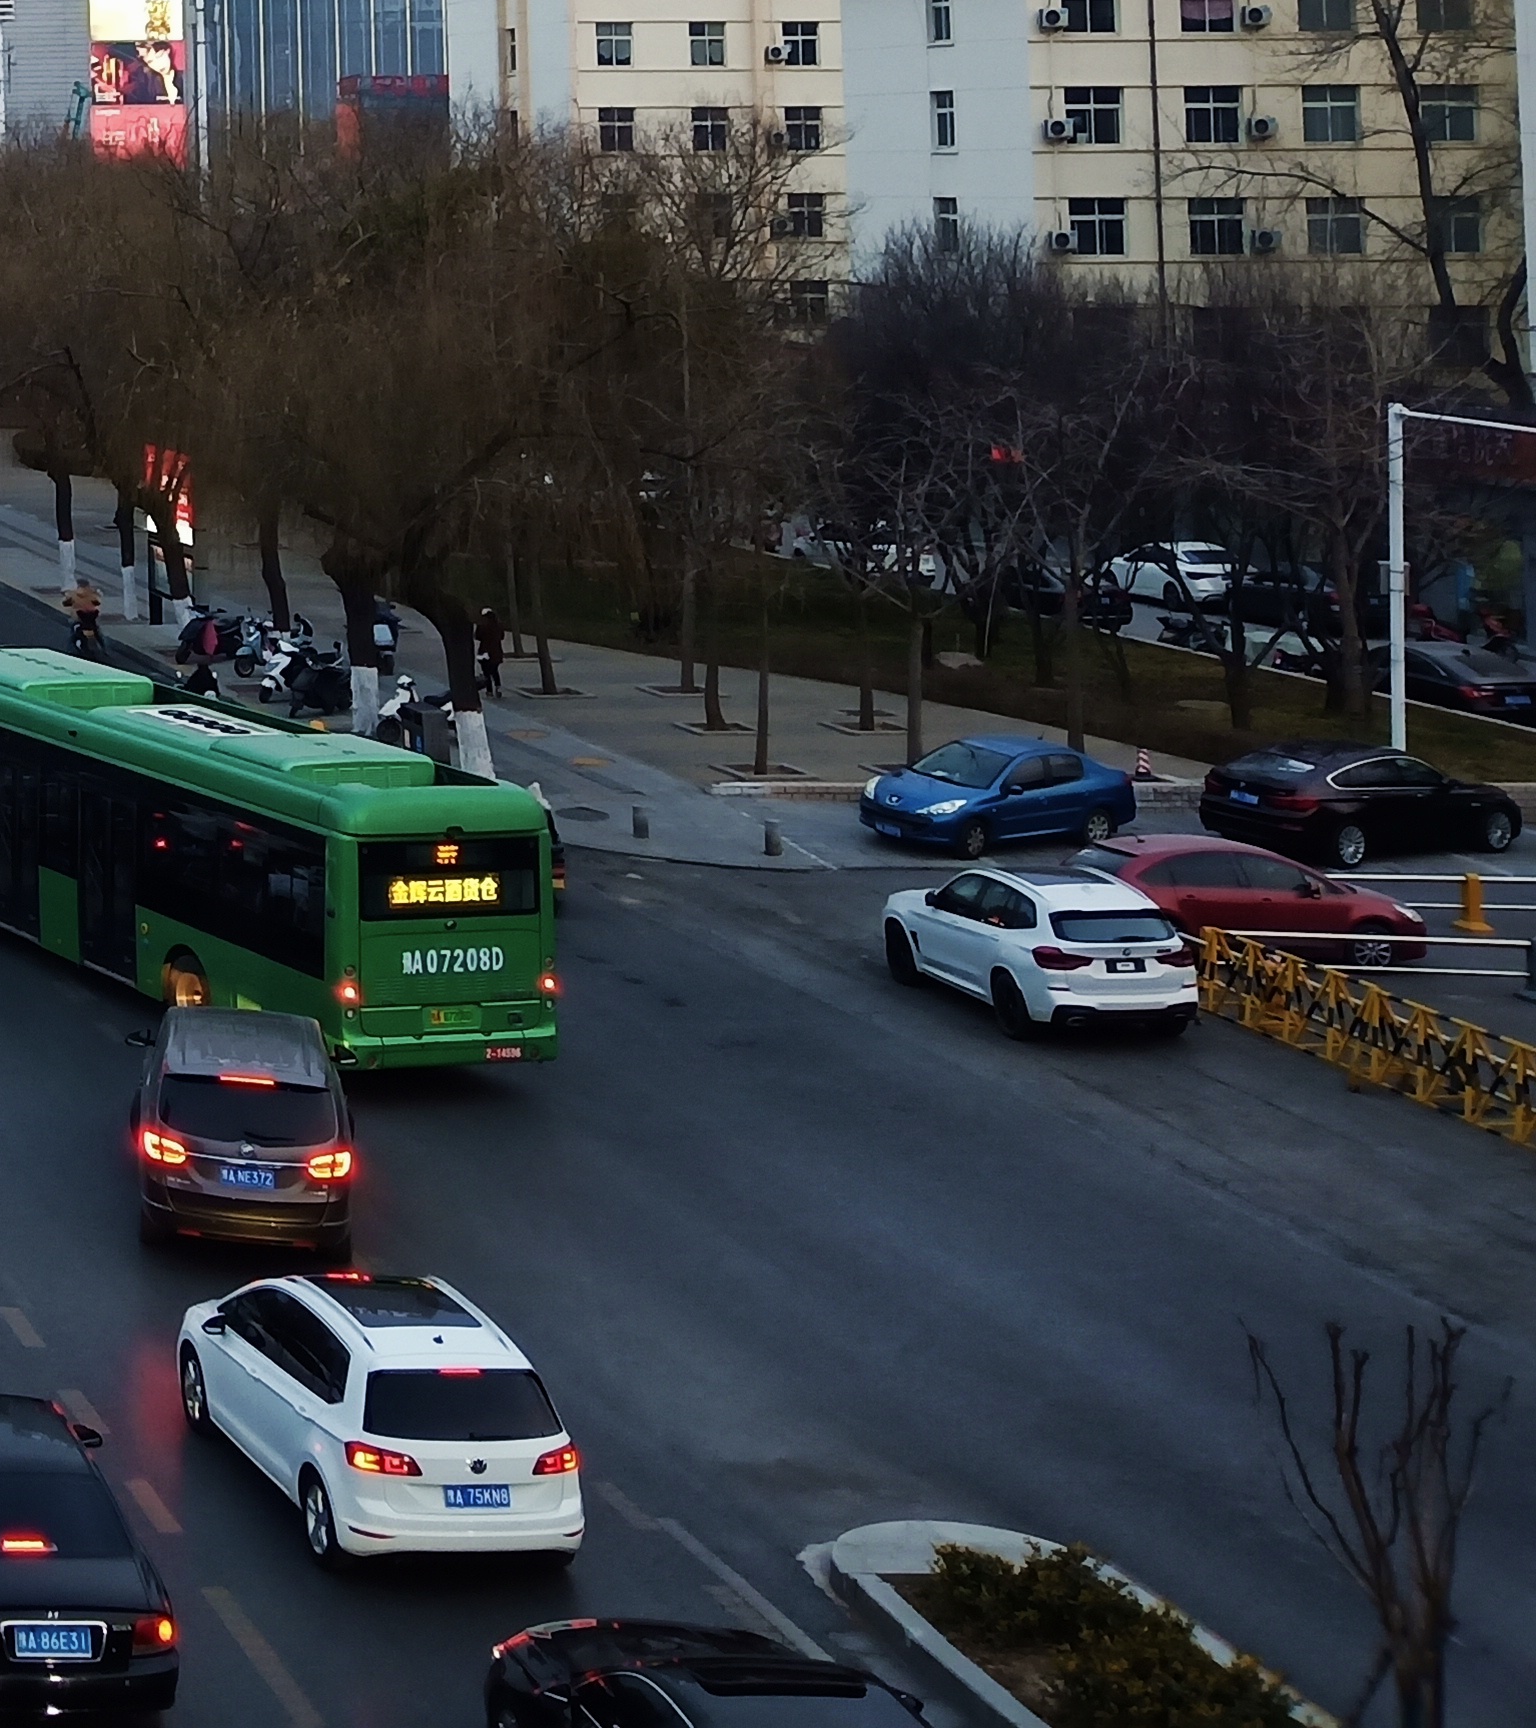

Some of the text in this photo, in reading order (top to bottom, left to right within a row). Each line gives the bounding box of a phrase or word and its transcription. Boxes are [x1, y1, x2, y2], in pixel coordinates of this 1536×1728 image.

[390, 876, 499, 905] 金辉云酒货仓
